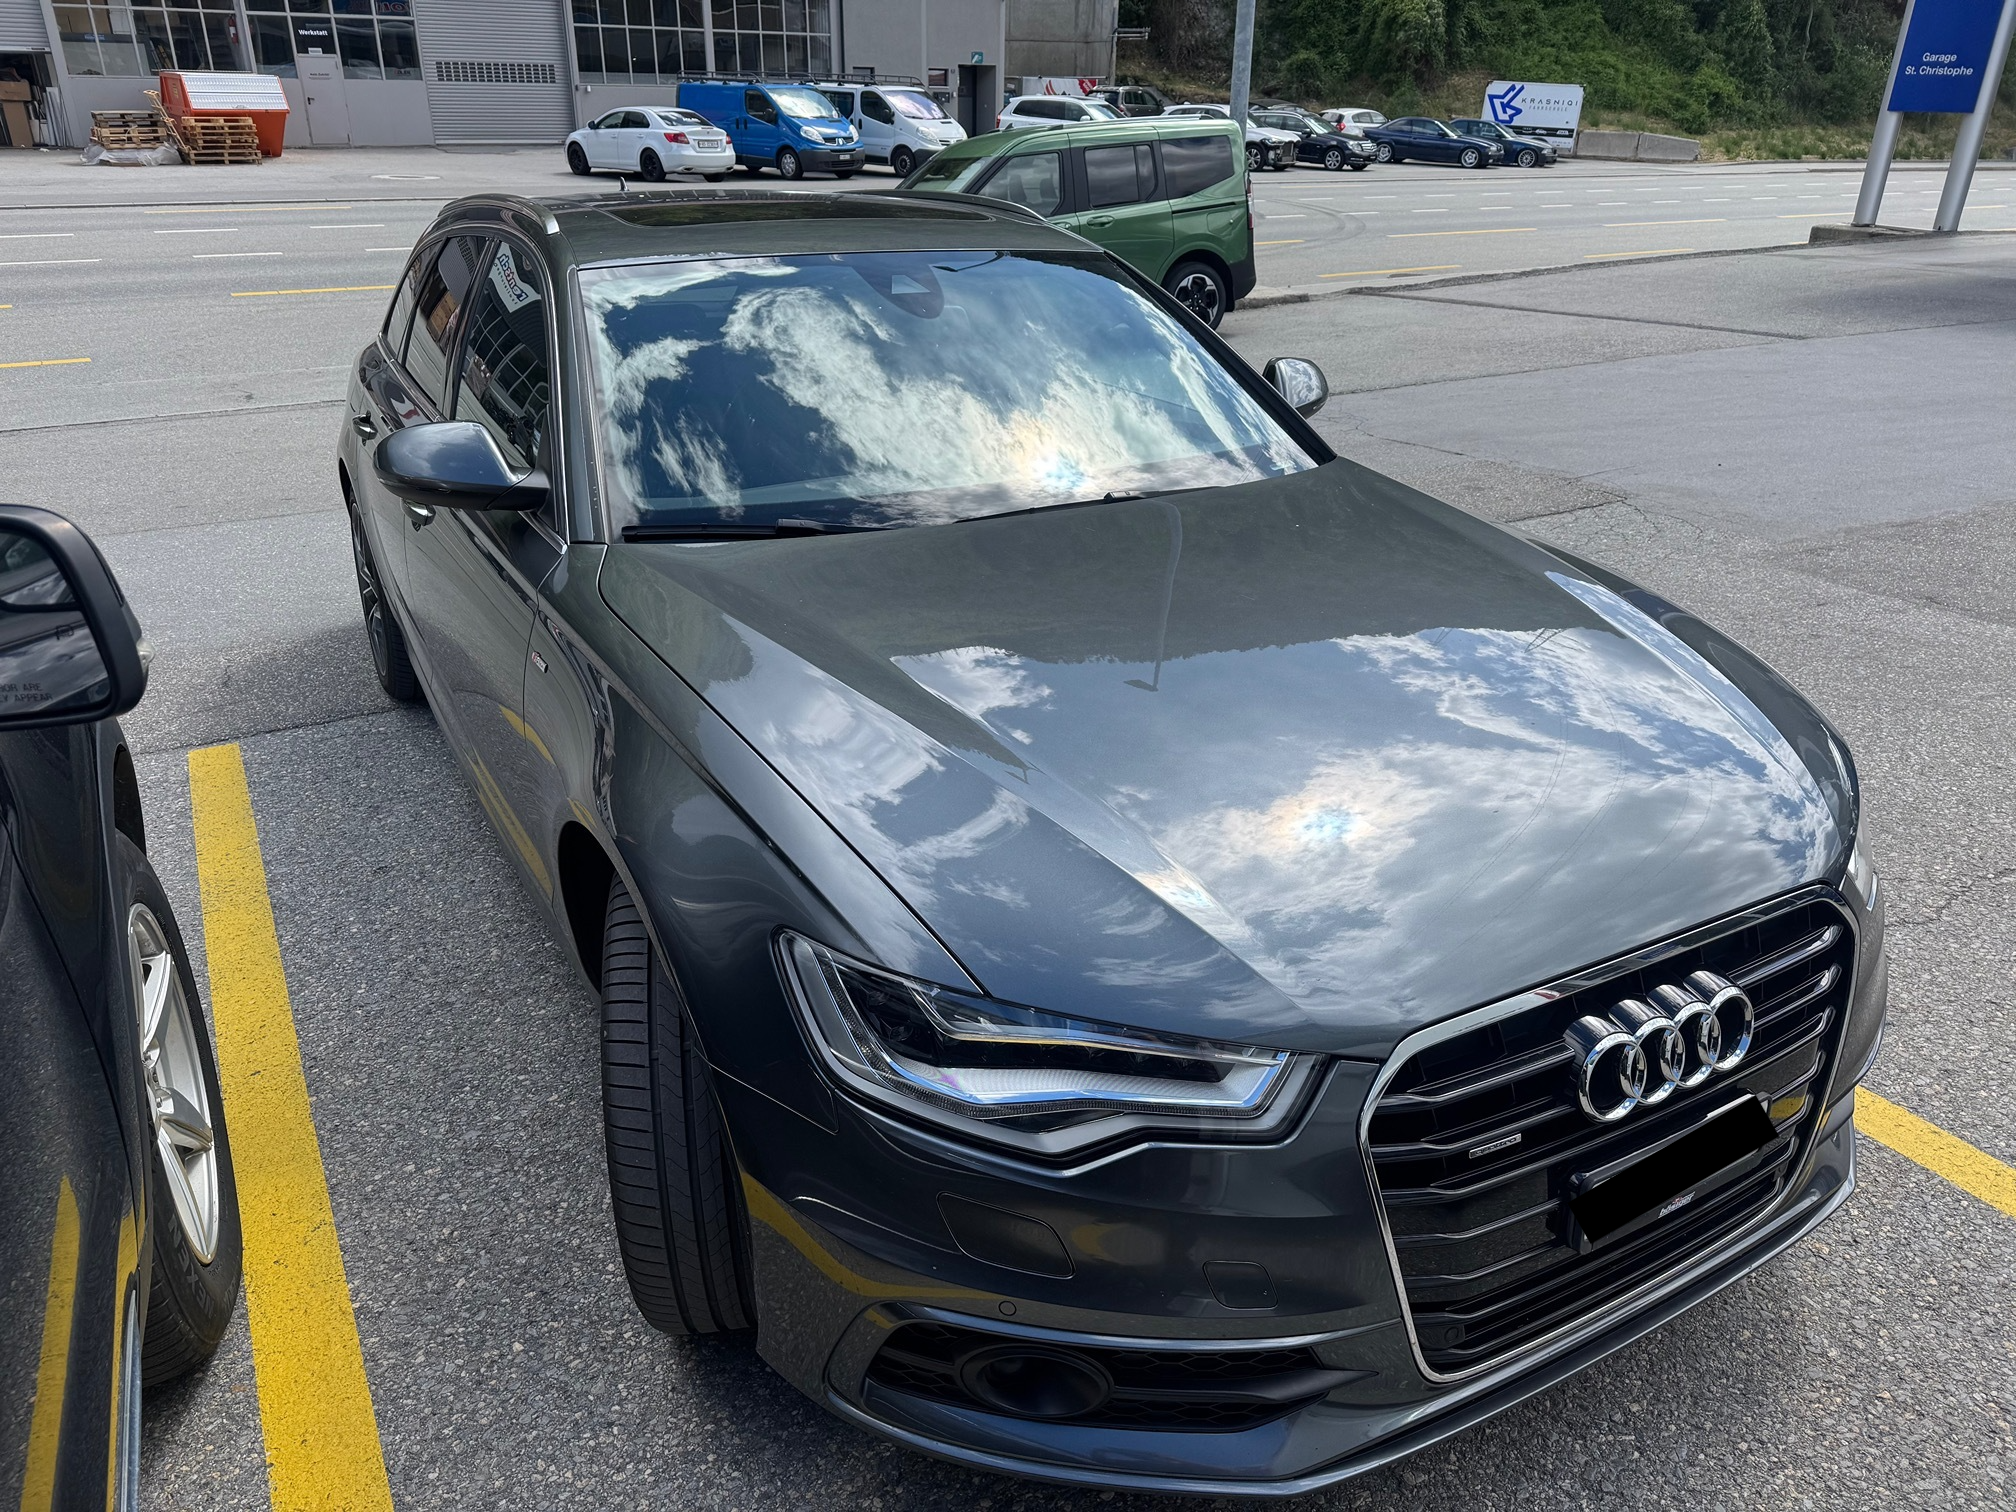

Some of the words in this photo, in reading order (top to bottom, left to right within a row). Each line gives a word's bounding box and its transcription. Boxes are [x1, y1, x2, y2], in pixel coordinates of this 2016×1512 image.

[1922, 52, 1957, 64] Garage
[1905, 65, 1917, 75] St.
[1919, 65, 1973, 77] Christophe
[1521, 97, 1578, 107] KRASNIQI
[23, 682, 43, 691] ARE
[15, 693, 53, 702] APPEAR
